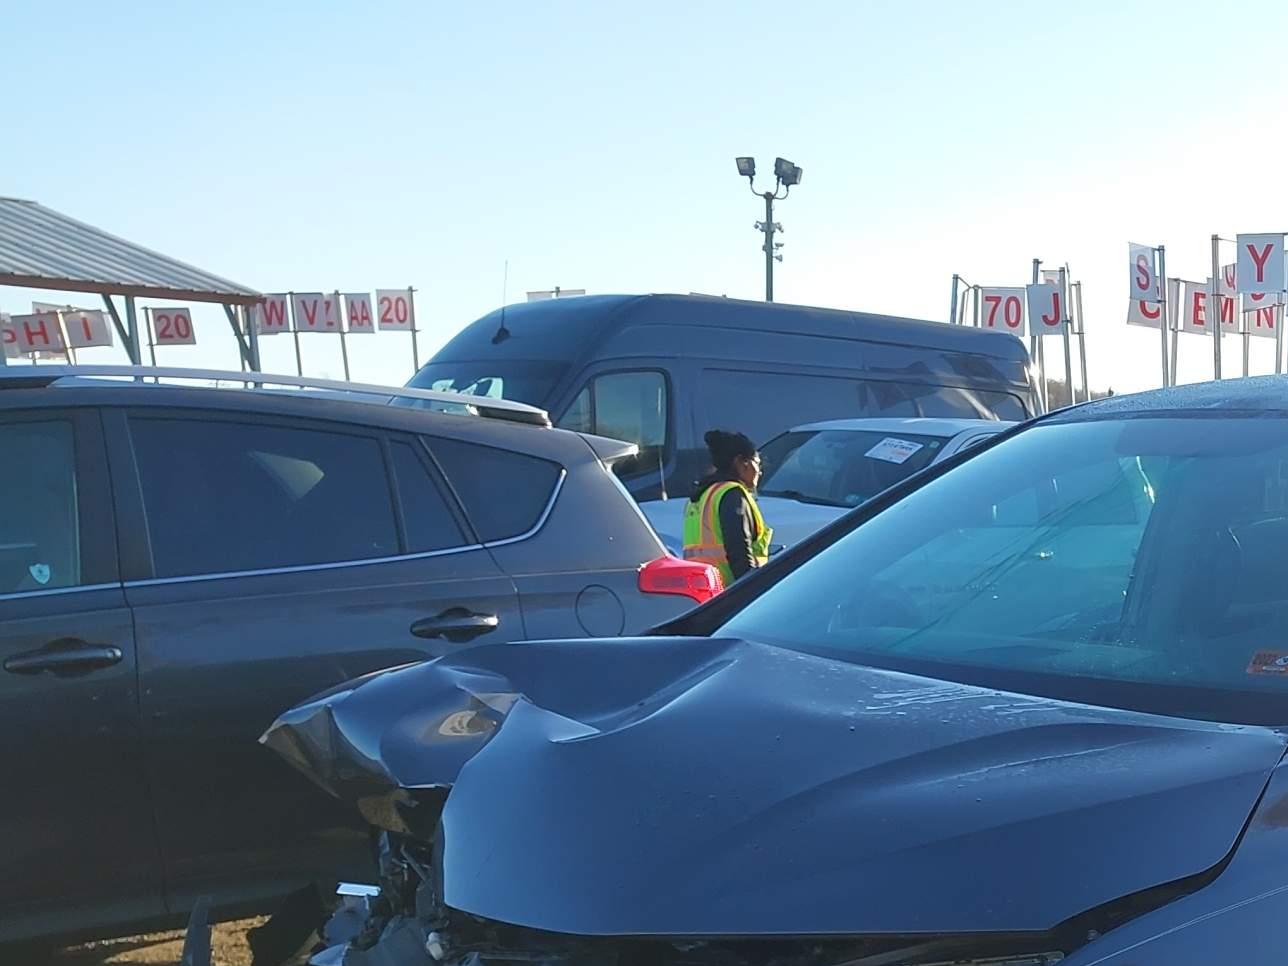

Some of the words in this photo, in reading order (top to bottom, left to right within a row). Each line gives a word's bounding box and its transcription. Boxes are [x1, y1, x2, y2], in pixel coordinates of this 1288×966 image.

[1136, 255, 1150, 290] S
[1246, 244, 1274, 282] Y
[262, 301, 285, 326] W
[301, 301, 317, 326] V
[350, 300, 372, 326] AA
[379, 297, 407, 324] 20
[984, 296, 1021, 328] 70
[1042, 293, 1060, 326] J
[1193, 292, 1206, 325] E
[1256, 307, 1274, 329] N
[23, 320, 49, 345] H
[81, 317, 92, 341] I
[157, 315, 190, 339] 20
